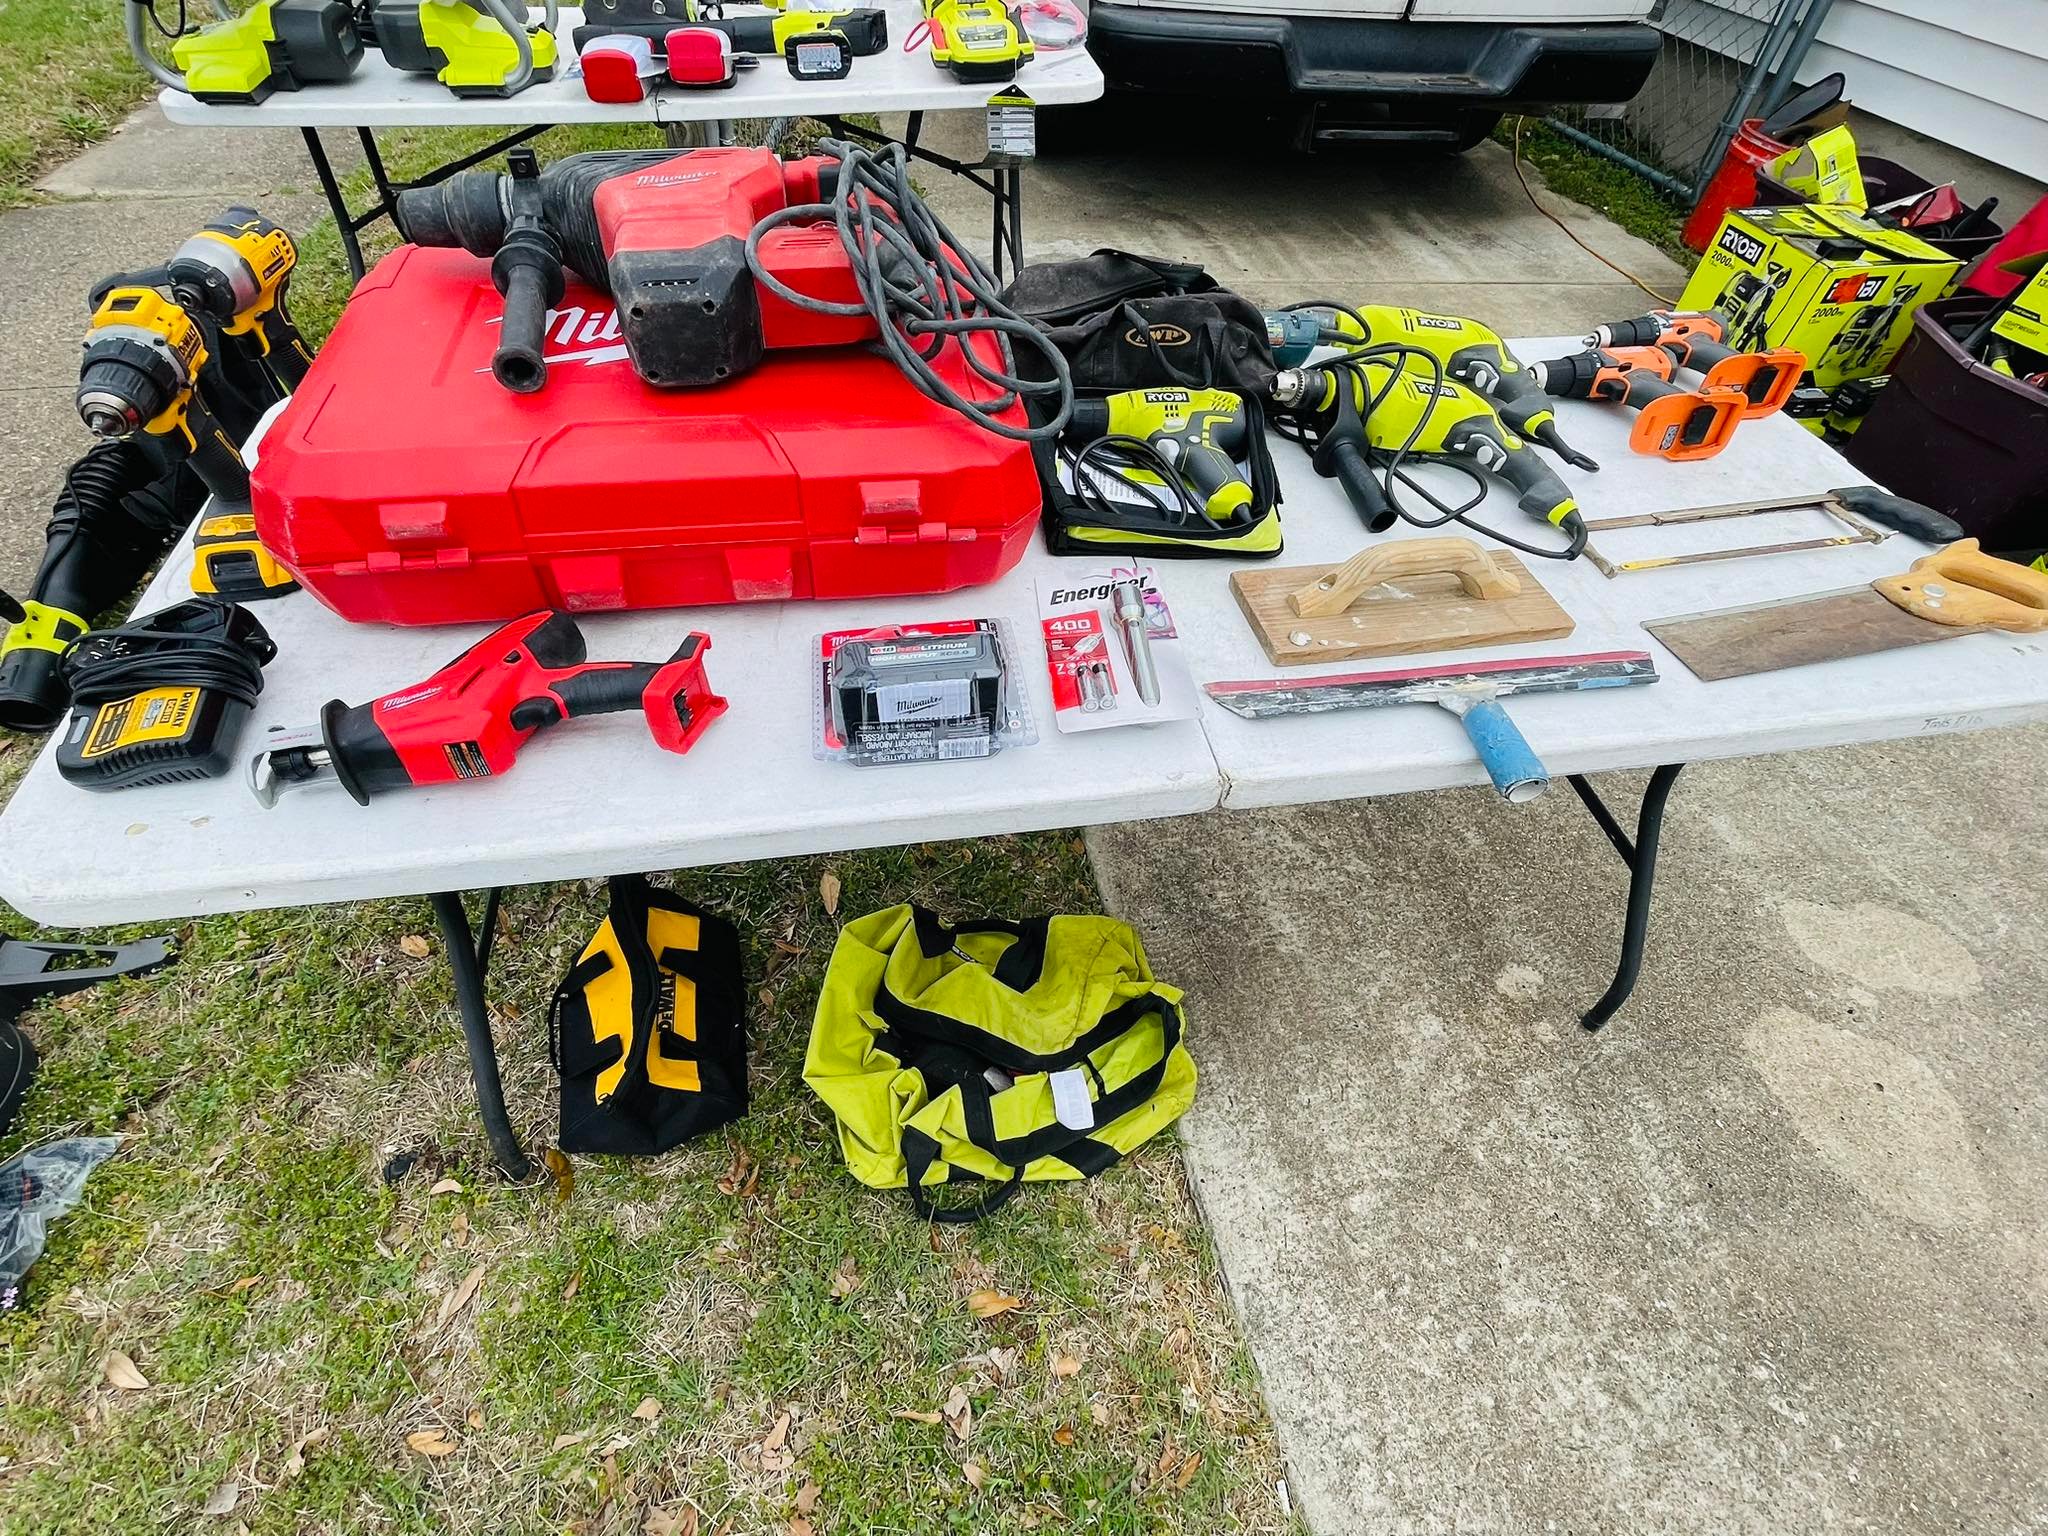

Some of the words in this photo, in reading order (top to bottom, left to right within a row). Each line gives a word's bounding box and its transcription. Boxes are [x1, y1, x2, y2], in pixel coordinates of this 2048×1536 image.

[1721, 228, 1764, 264] RYOBI
[1711, 250, 1732, 268] 2000
[1812, 307, 1839, 318] 2000
[1419, 317, 1460, 329] RYOBI
[1146, 392, 1187, 401] RYOBI
[1050, 619, 1091, 631] 400
[870, 646, 895, 654] M18
[897, 642, 968, 653] REDLITHIUM
[871, 654, 896, 662] HIGH
[898, 652, 938, 661] OUTPUT
[382, 685, 443, 709] Milwaukee
[171, 691, 193, 728] DEWALT
[896, 695, 944, 713] Milwaukee
[886, 732, 900, 741] AND
[901, 730, 933, 740] AIRCRAFT
[866, 740, 893, 750] ABOARD
[894, 738, 933, 748] TRANSPORT
[872, 752, 906, 762] BATTERIES
